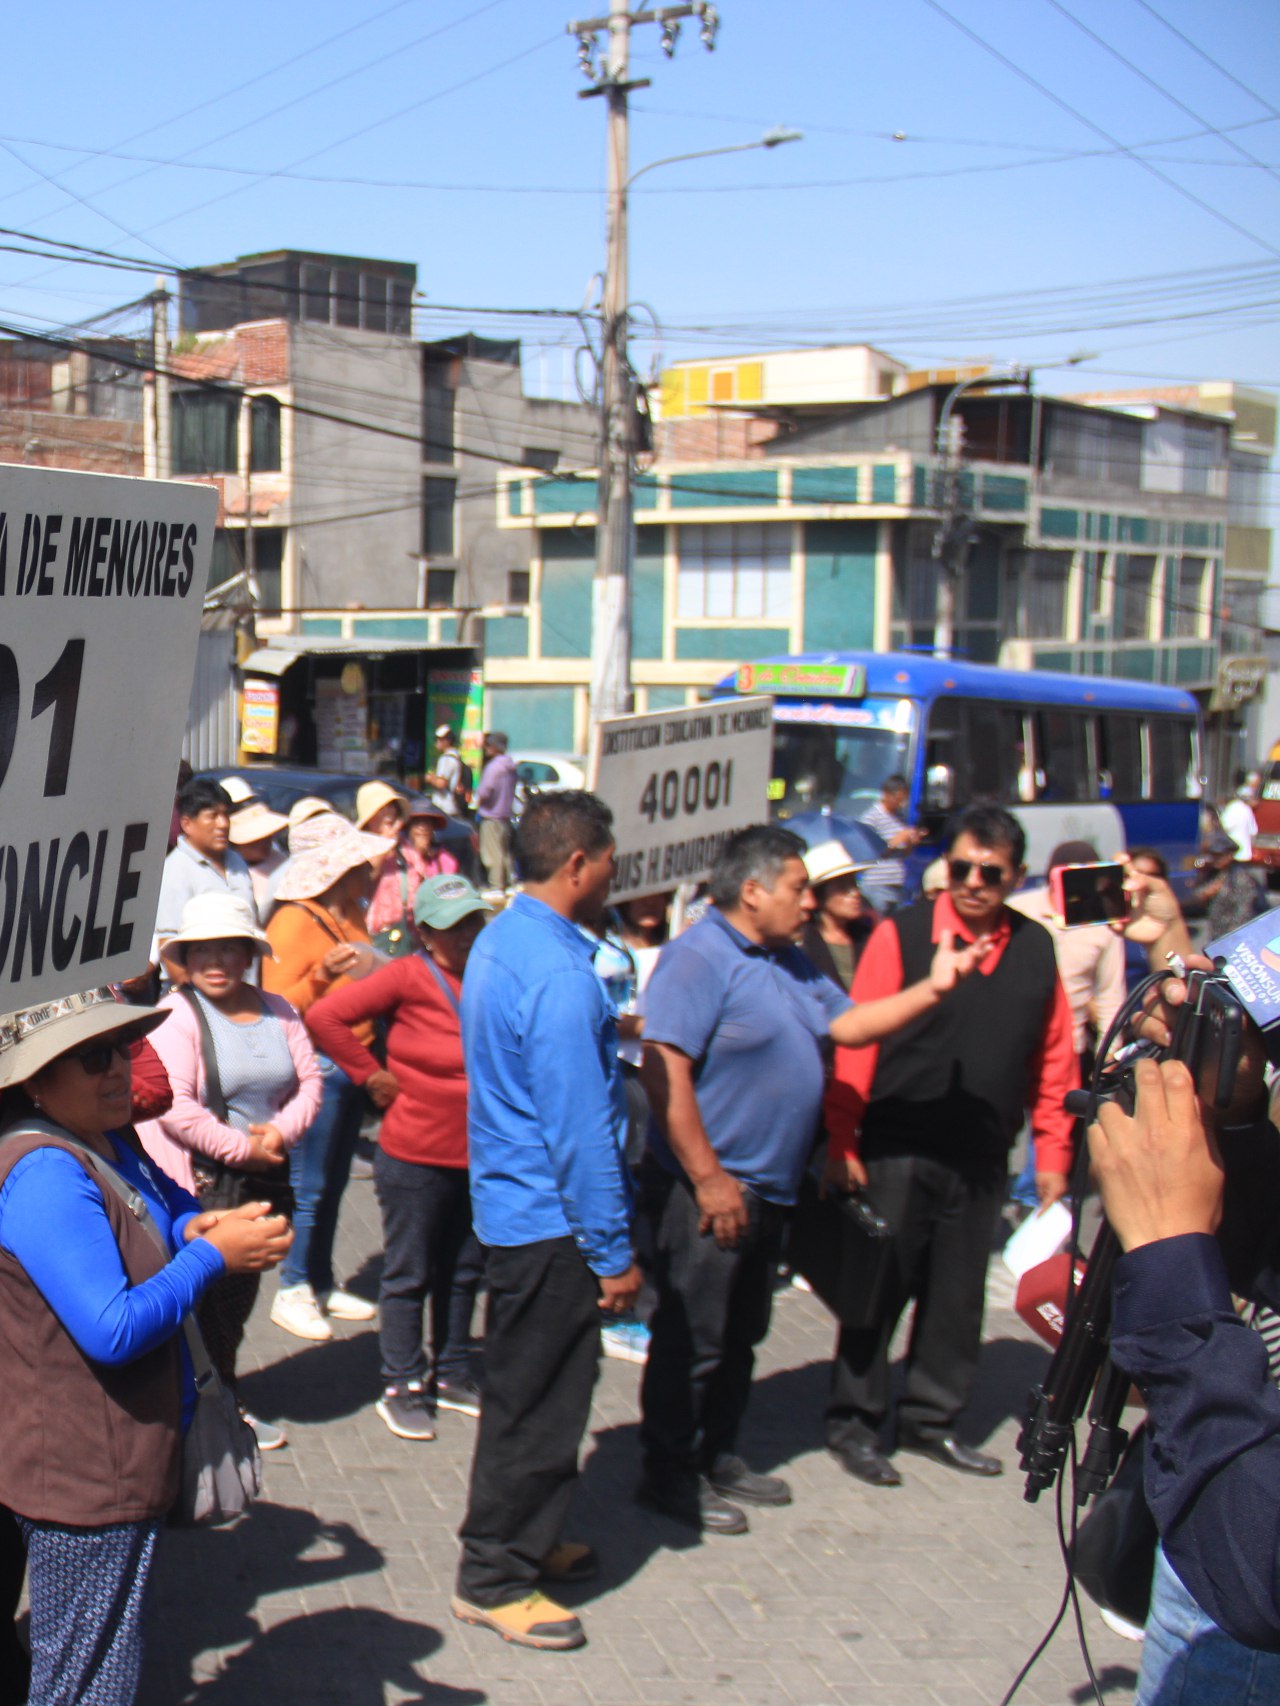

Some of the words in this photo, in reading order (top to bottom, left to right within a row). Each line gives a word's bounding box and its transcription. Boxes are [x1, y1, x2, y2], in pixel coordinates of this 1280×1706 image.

[16, 514, 61, 597] DE
[63, 517, 197, 598] MENORES
[738, 664, 754, 692] 3
[664, 715, 712, 746] EDUCATIVA
[718, 713, 728, 736] DE
[639, 758, 733, 824] 40001
[611, 851, 642, 892] UIS
